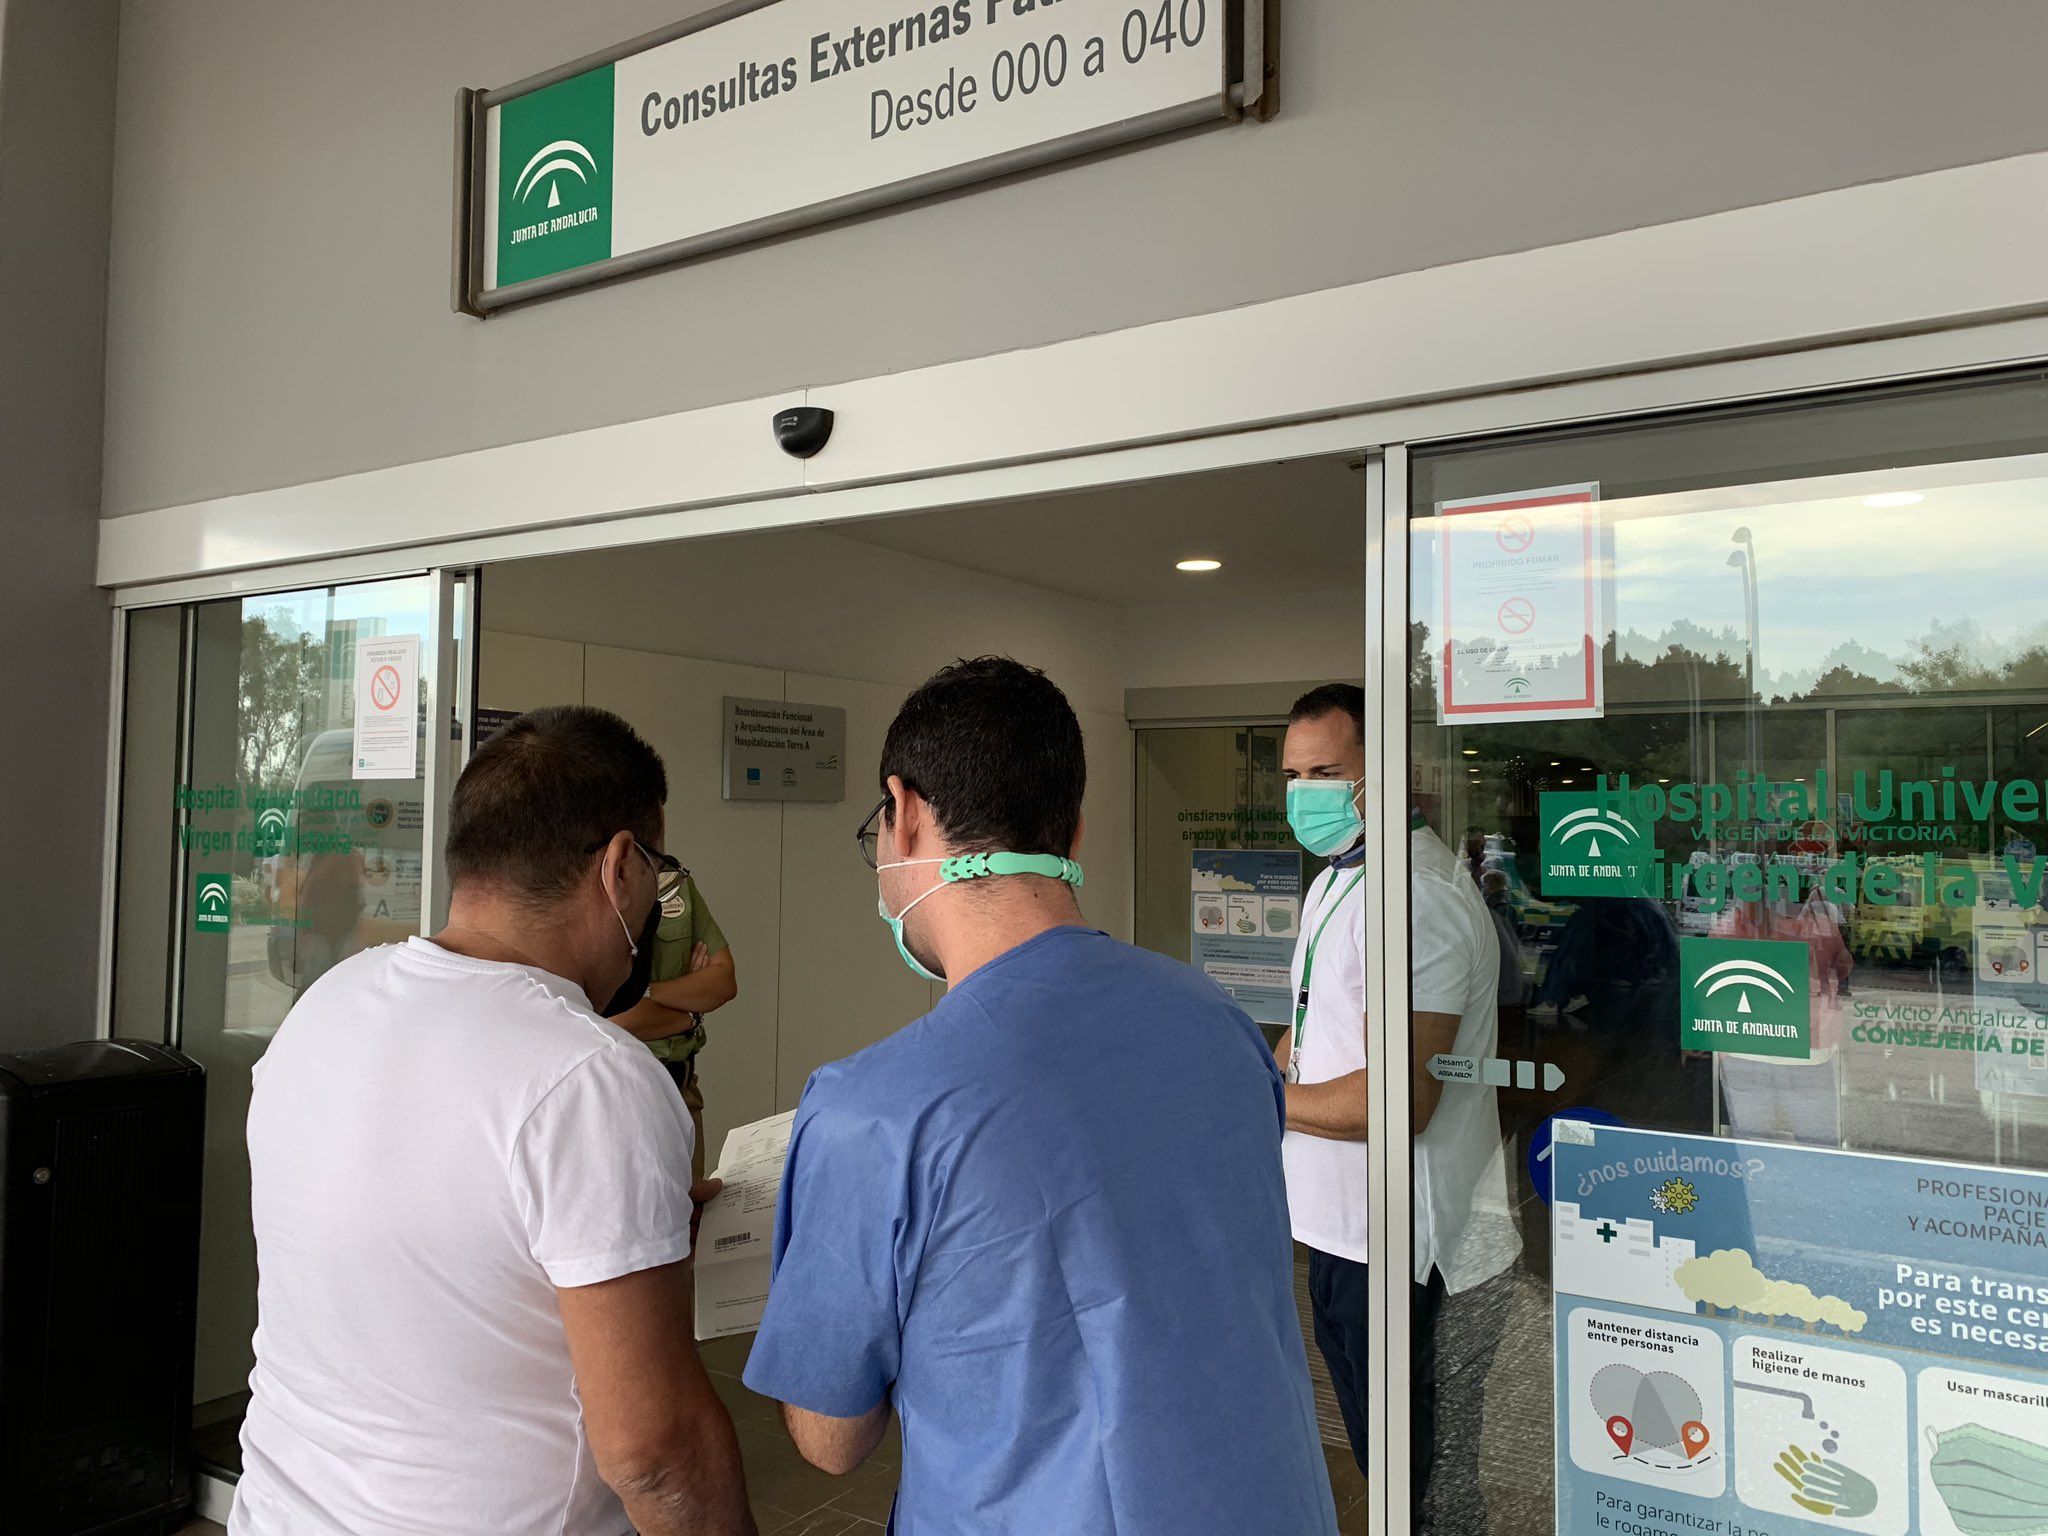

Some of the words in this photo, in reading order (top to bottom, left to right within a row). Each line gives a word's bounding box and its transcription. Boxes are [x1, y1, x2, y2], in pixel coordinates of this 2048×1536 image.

[640, 54, 798, 137] Consultas
[809, 0, 972, 84] Externas
[870, 66, 977, 140] Desde
[991, 33, 1068, 104] 000
[1082, 36, 1105, 77] a
[1121, 0, 1206, 65] 040
[511, 225, 538, 245] JUNTA
[538, 220, 549, 237] DE
[550, 206, 598, 233] ANDALUCIA
[1472, 557, 1525, 570] PROHIBIDO
[1526, 553, 1561, 566] FUMAR
[1466, 647, 1479, 655] USO
[734, 706, 781, 720] Reordenación
[782, 710, 813, 723] Funcional
[734, 723, 739, 733] y
[790, 725, 800, 736] del
[734, 736, 786, 750] Hospitalización
[786, 740, 804, 751] Torre
[804, 740, 811, 751] A
[1597, 769, 1828, 835] Hospital
[1853, 766, 2048, 823] Unive
[1849, 825, 1957, 842] VICTORIA
[1548, 864, 1577, 878] JUNTA
[1579, 865, 1591, 877] DE
[1613, 846, 1801, 914] Virgen
[1824, 851, 1898, 906] de
[1924, 852, 1978, 909] la
[1852, 1000, 1932, 1023] Servicio
[1938, 1006, 2028, 1030] Andaluz
[1692, 1018, 1723, 1033] JUNTA
[1725, 1020, 1739, 1034] DE
[1742, 1022, 1799, 1039] ANDALUCIA
[1852, 1025, 2003, 1054] CONSEJERÍA
[2011, 1036, 2045, 1057] DE
[1437, 1057, 1464, 1067] besam
[1438, 1069, 1454, 1078] ASSA
[1454, 1071, 1473, 1079] ABLOY
[1577, 1160, 1630, 1197] ¿nos
[1633, 1147, 1766, 1181] cuidamos?
[1908, 1215, 1919, 1232] Y
[1896, 1263, 1961, 1293] Para
[1878, 1287, 1927, 1310] por
[1935, 1296, 1998, 1322] este
[1587, 1318, 1643, 1338] Mantener
[1644, 1327, 1700, 1348] distancia
[1911, 1315, 1942, 1336] es
[1587, 1330, 1618, 1345] entre
[1620, 1335, 1675, 1355] personas
[1752, 1346, 1804, 1365] Realizar
[1752, 1358, 1800, 1378] higiene
[1802, 1367, 1819, 1381] de
[1821, 1372, 1866, 1389] manos
[1947, 1380, 1980, 1396] Usar
[1596, 1491, 1632, 1513] Para
[1636, 1502, 1724, 1534] garantizar
[1728, 1520, 1742, 1536] la
[1596, 1511, 1610, 1529] le
